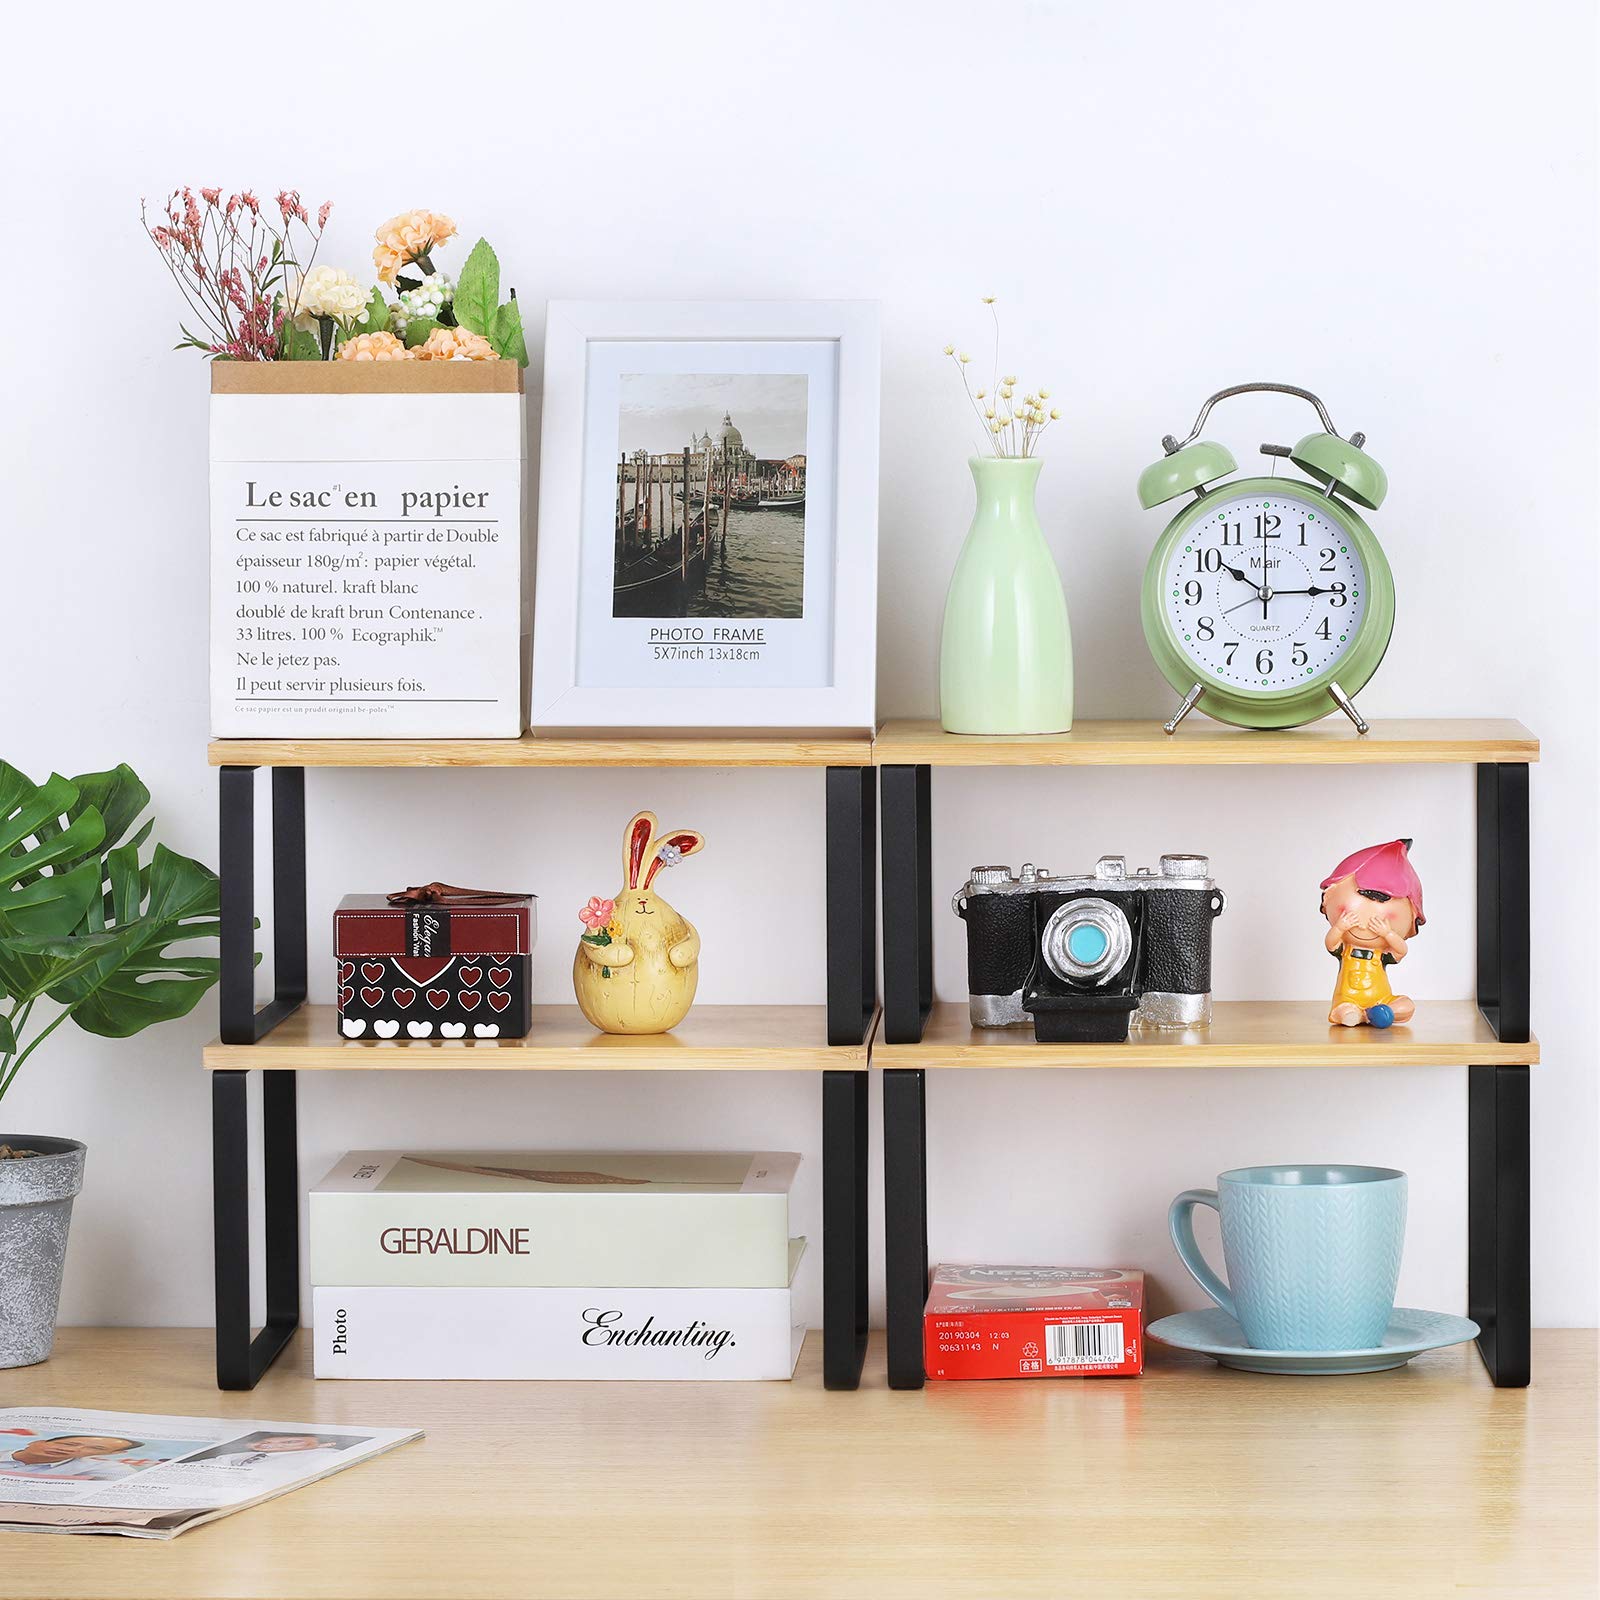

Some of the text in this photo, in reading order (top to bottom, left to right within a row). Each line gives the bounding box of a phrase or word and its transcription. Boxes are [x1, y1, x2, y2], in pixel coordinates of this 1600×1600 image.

[245, 482, 283, 508] Le
[344, 492, 378, 508] en
[400, 485, 490, 517] papier
[236, 528, 499, 547] Ce sac est fabriqué à partir de Double
[1221, 523, 1243, 545] 11
[1254, 515, 1281, 538] 12
[1297, 523, 1308, 546] 1
[235, 555, 302, 572] épaisseur
[374, 555, 420, 571] papier
[424, 555, 476, 572] végétal.
[1195, 548, 1222, 572] 10
[1320, 548, 1336, 571] 2
[237, 580, 419, 594] 100 % naturel. kraft blanc
[1185, 580, 1201, 605] 9
[1330, 582, 1347, 607] 3
[236, 605, 286, 619] doublé
[290, 605, 308, 619] de
[311, 605, 345, 619] kraft
[349, 605, 384, 619] brun
[236, 628, 253, 641] 33
[257, 628, 296, 641] litres.
[302, 628, 326, 641] 100
[329, 628, 344, 641] %
[650, 628, 764, 641] PHOTO FRAME
[1197, 617, 1215, 641] 8
[1315, 617, 1332, 640] 4
[236, 652, 341, 671] Ne le jetez pas.
[708, 648, 760, 660] 13x18cm
[1223, 643, 1239, 665] 7
[1256, 650, 1273, 674] 6
[1292, 642, 1308, 666] 5
[236, 677, 426, 696] Il peut servir plusieurs fois.
[327, 707, 357, 715] original
[380, 1228, 530, 1254] GERALDINE
[333, 1308, 347, 1355] Photo
[582, 1308, 736, 1359] Enchanting.
[939, 1331, 980, 1340] 20190304
[939, 1343, 982, 1352] 90631143
[1022, 1361, 1040, 1371] 合格
